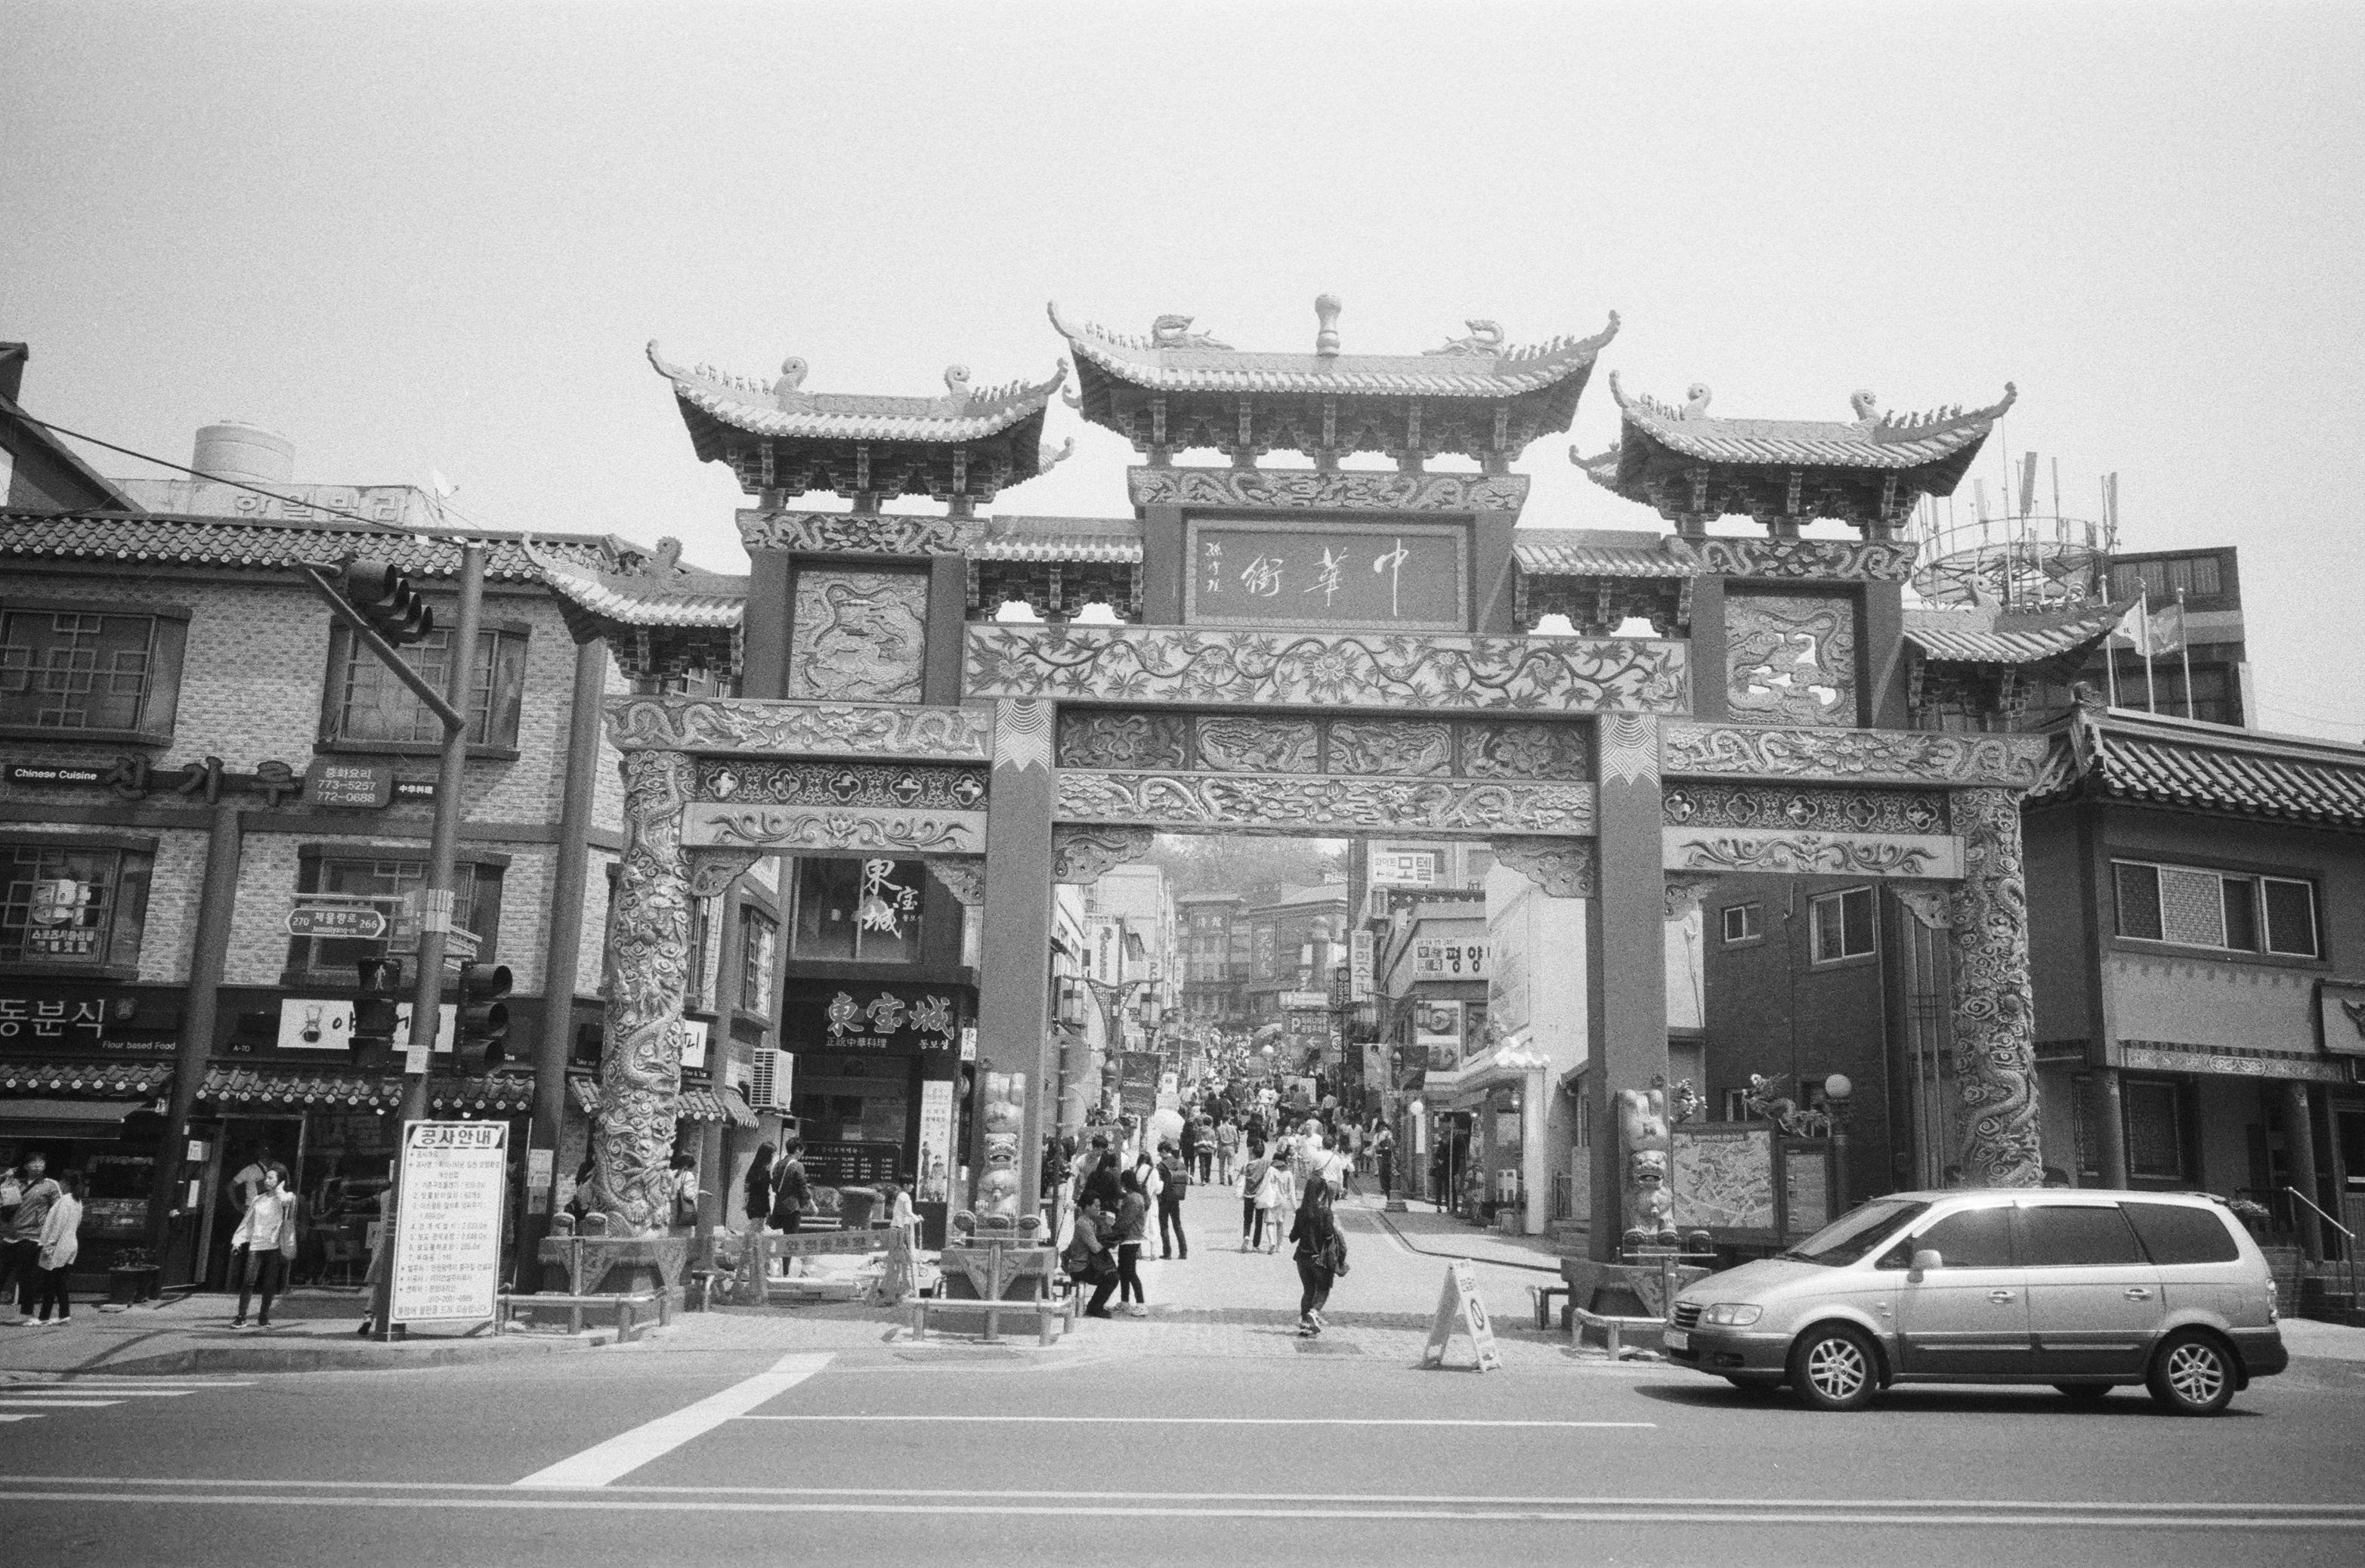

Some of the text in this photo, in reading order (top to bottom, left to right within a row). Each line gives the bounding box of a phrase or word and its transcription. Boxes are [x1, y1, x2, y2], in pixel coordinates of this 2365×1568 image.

[15, 769, 97, 781] Chinese Cuisine
[318, 780, 376, 791] 773-5257
[1398, 856, 1432, 881] 모텔
[292, 912, 377, 929] 270 제물량로 266
[1445, 945, 1491, 973] 평양
[103, 1041, 175, 1050] Flour based Food
[919, 1039, 949, 1050] 동보성
[421, 1129, 490, 1146] 공사안내
